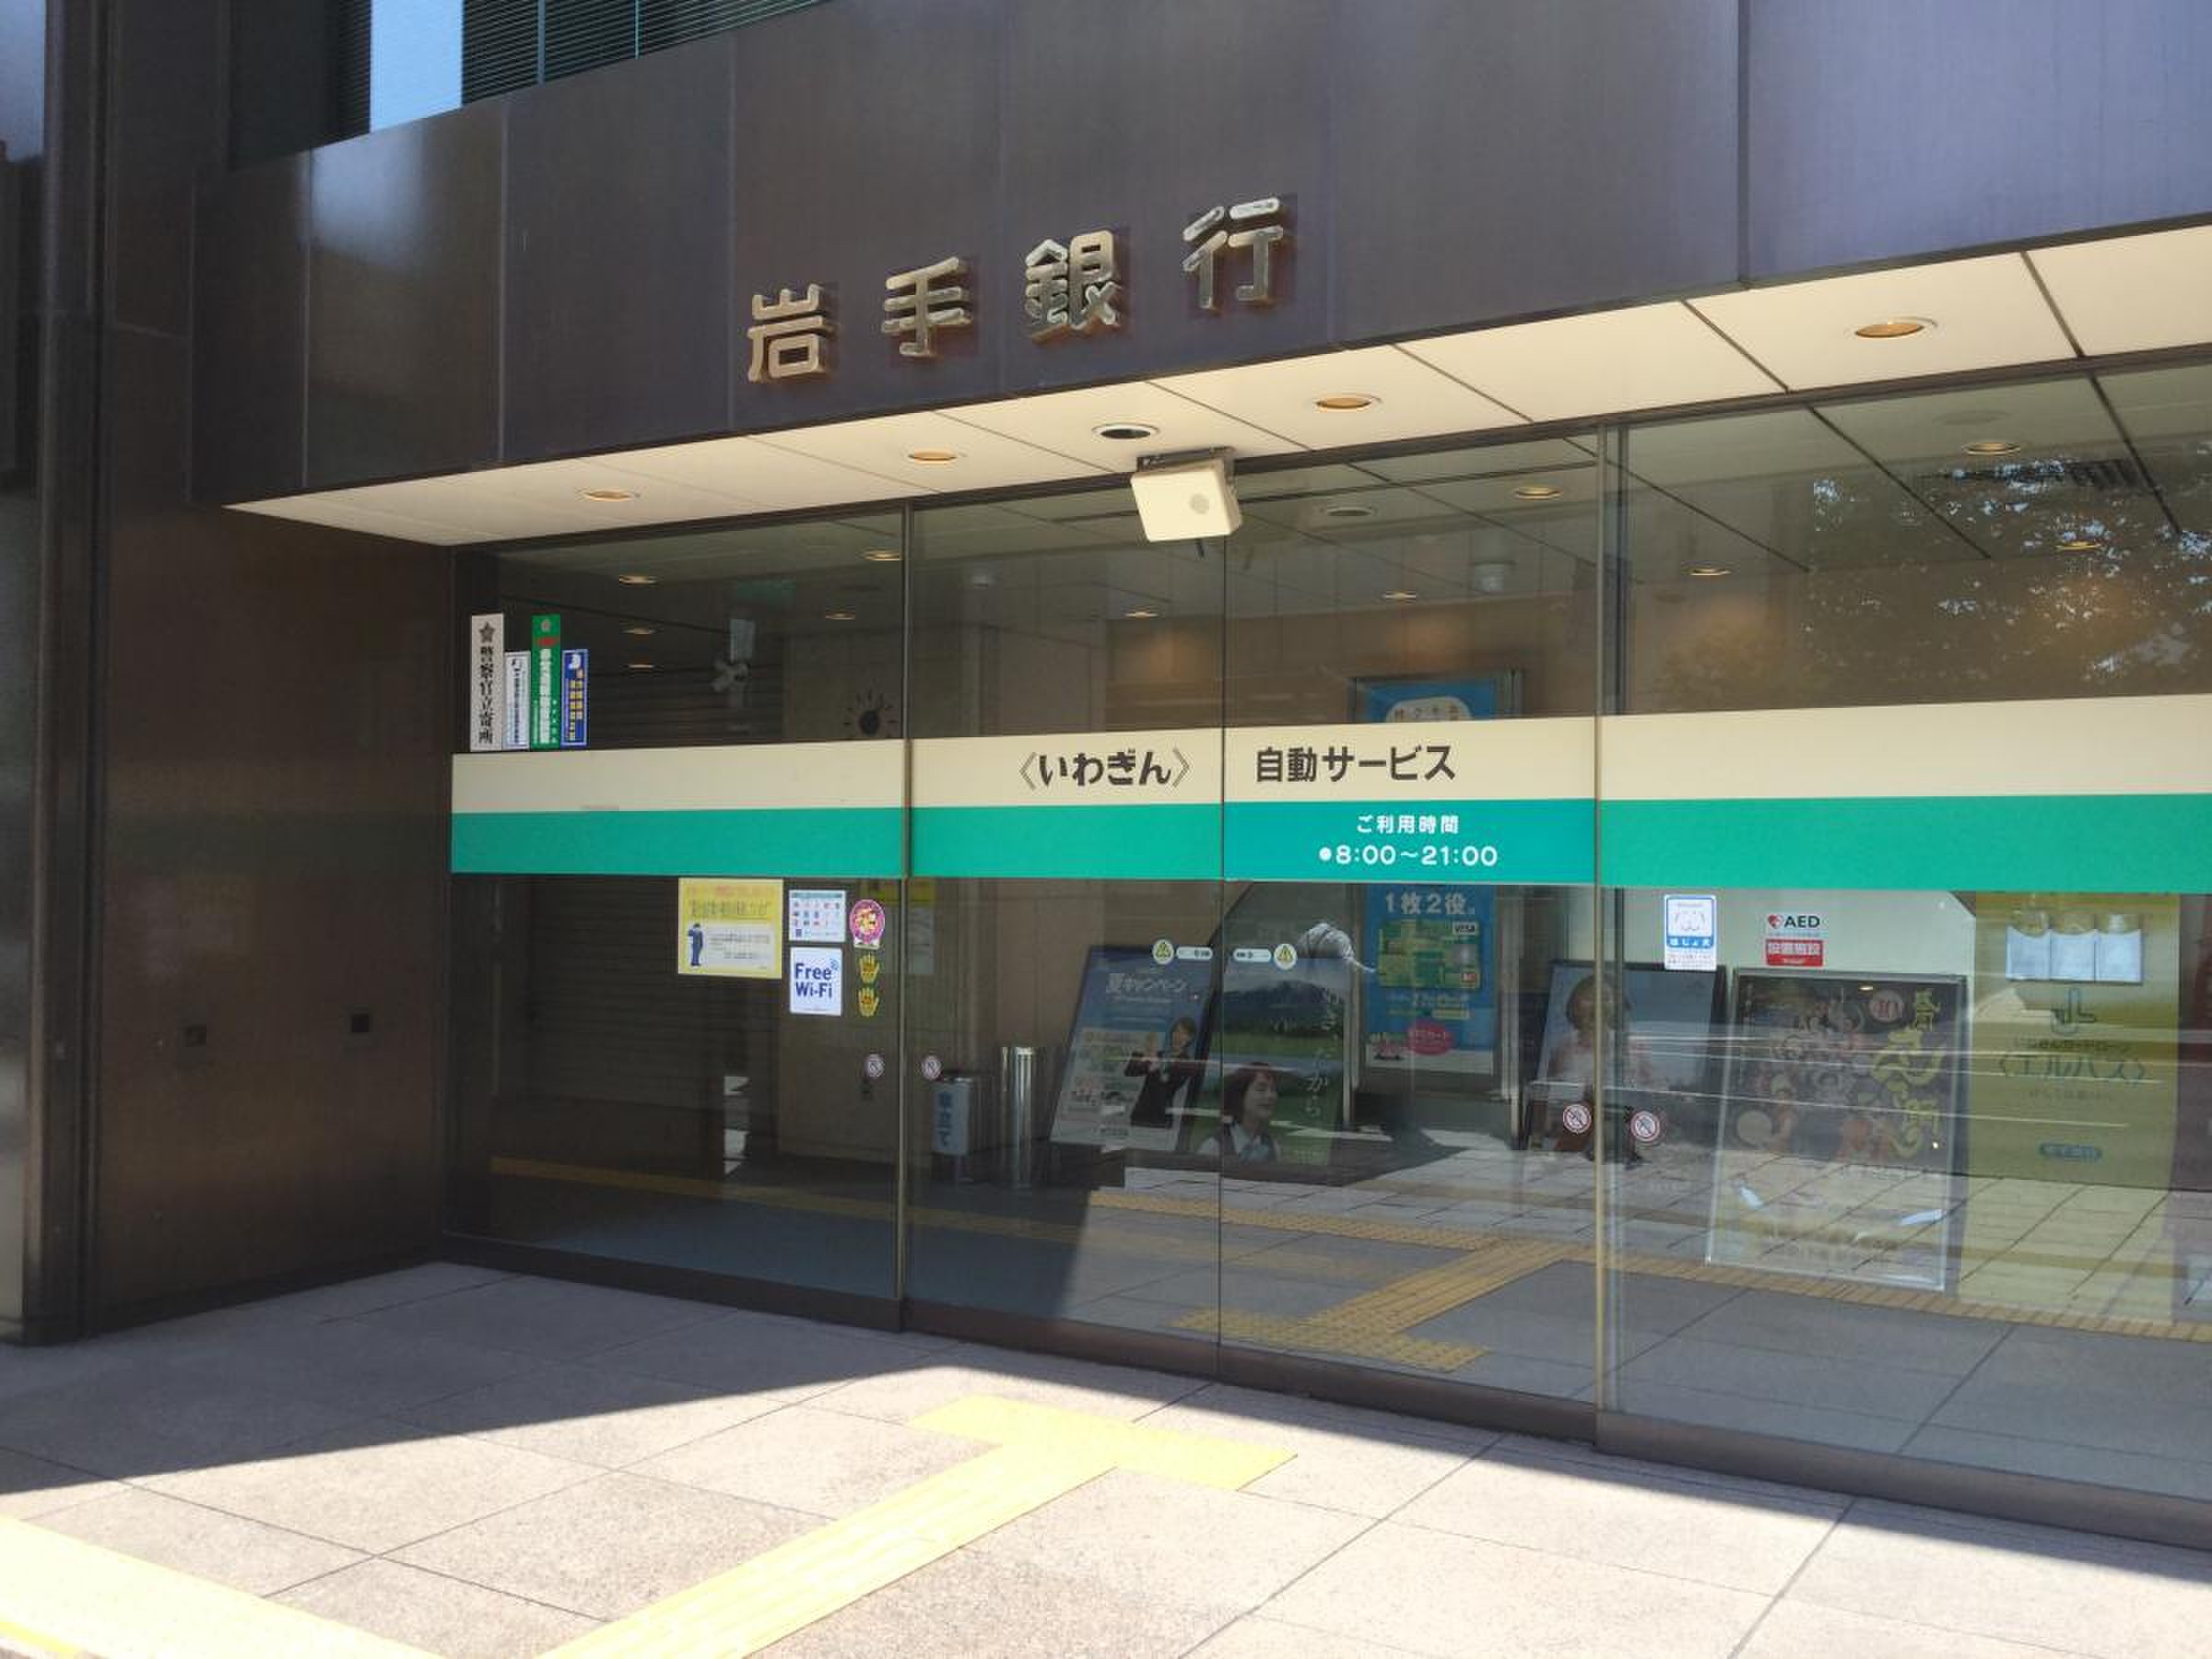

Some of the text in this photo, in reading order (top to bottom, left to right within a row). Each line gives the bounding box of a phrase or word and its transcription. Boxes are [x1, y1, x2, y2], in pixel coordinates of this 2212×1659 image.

[746, 196, 1284, 383] 岩手銀行
[1254, 745, 1456, 783] 自動サービス
[1356, 815, 1460, 835] ご利用時間
[1784, 915, 1820, 928] AED
[795, 963, 832, 981] Free
[795, 982, 832, 998] Wi-Fi
